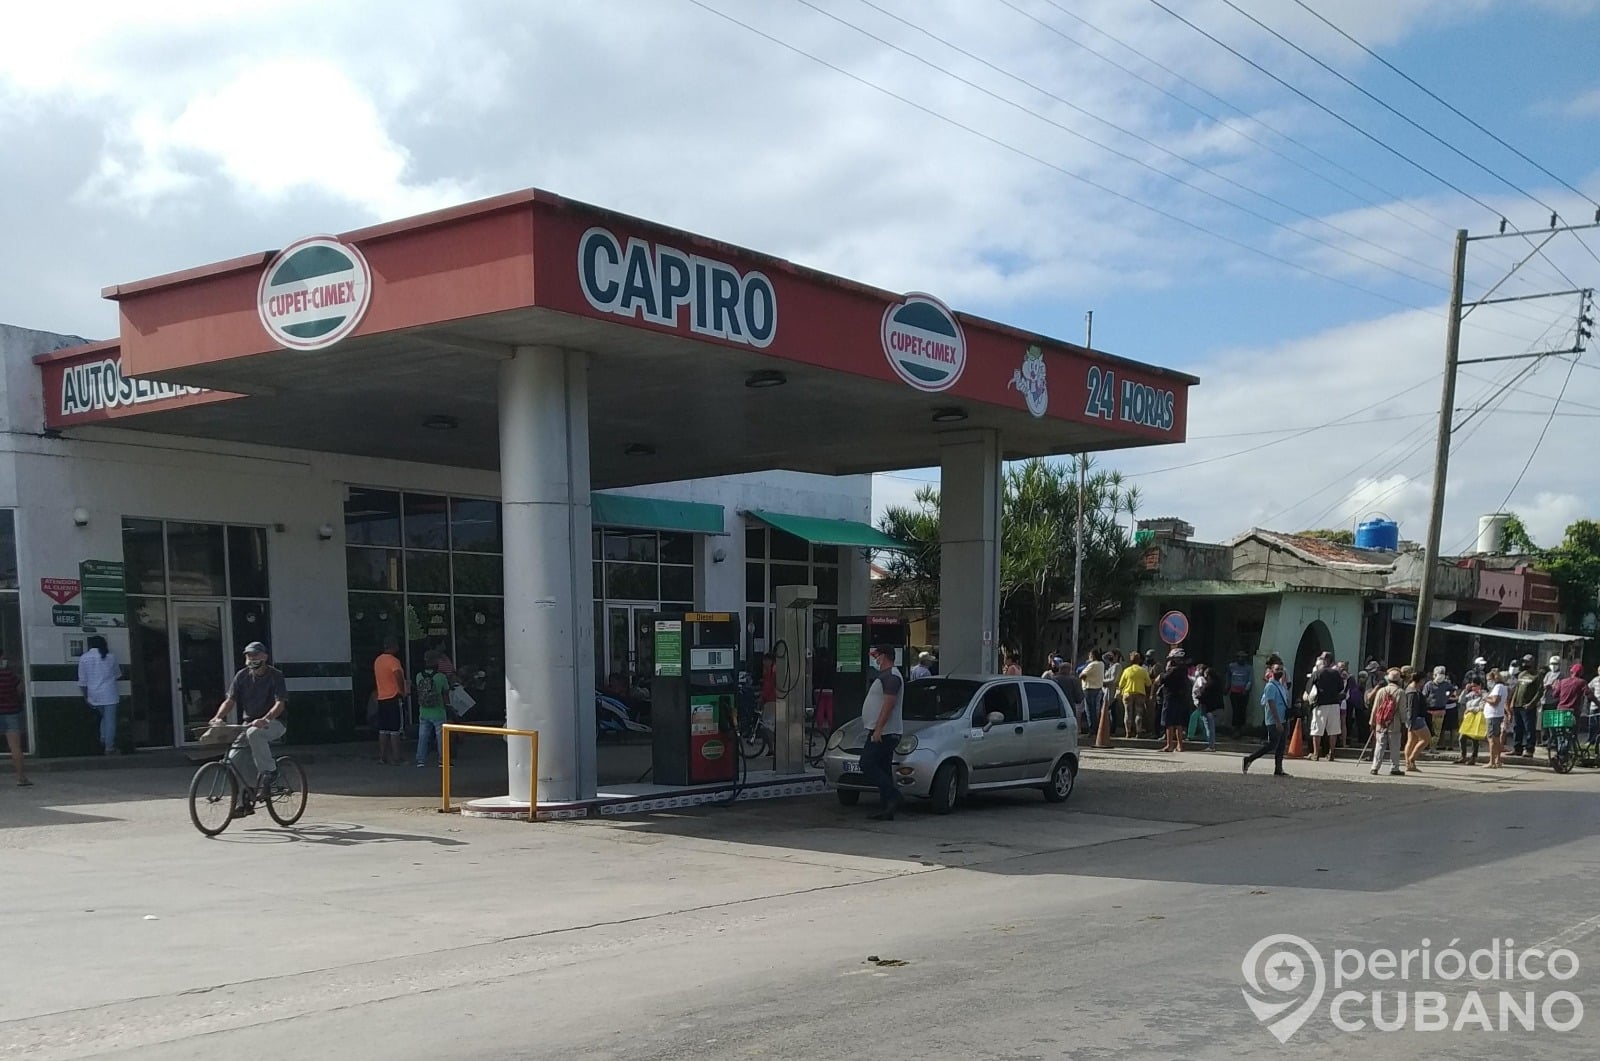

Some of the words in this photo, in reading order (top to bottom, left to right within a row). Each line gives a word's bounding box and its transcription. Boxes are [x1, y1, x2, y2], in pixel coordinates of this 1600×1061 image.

[268, 280, 356, 318] CUPET-CIMEX
[577, 226, 778, 349] CAPIRO
[890, 330, 957, 365] CUPET-CIMEX
[1084, 366, 1115, 420] 24
[1120, 379, 1175, 431] HORAS
